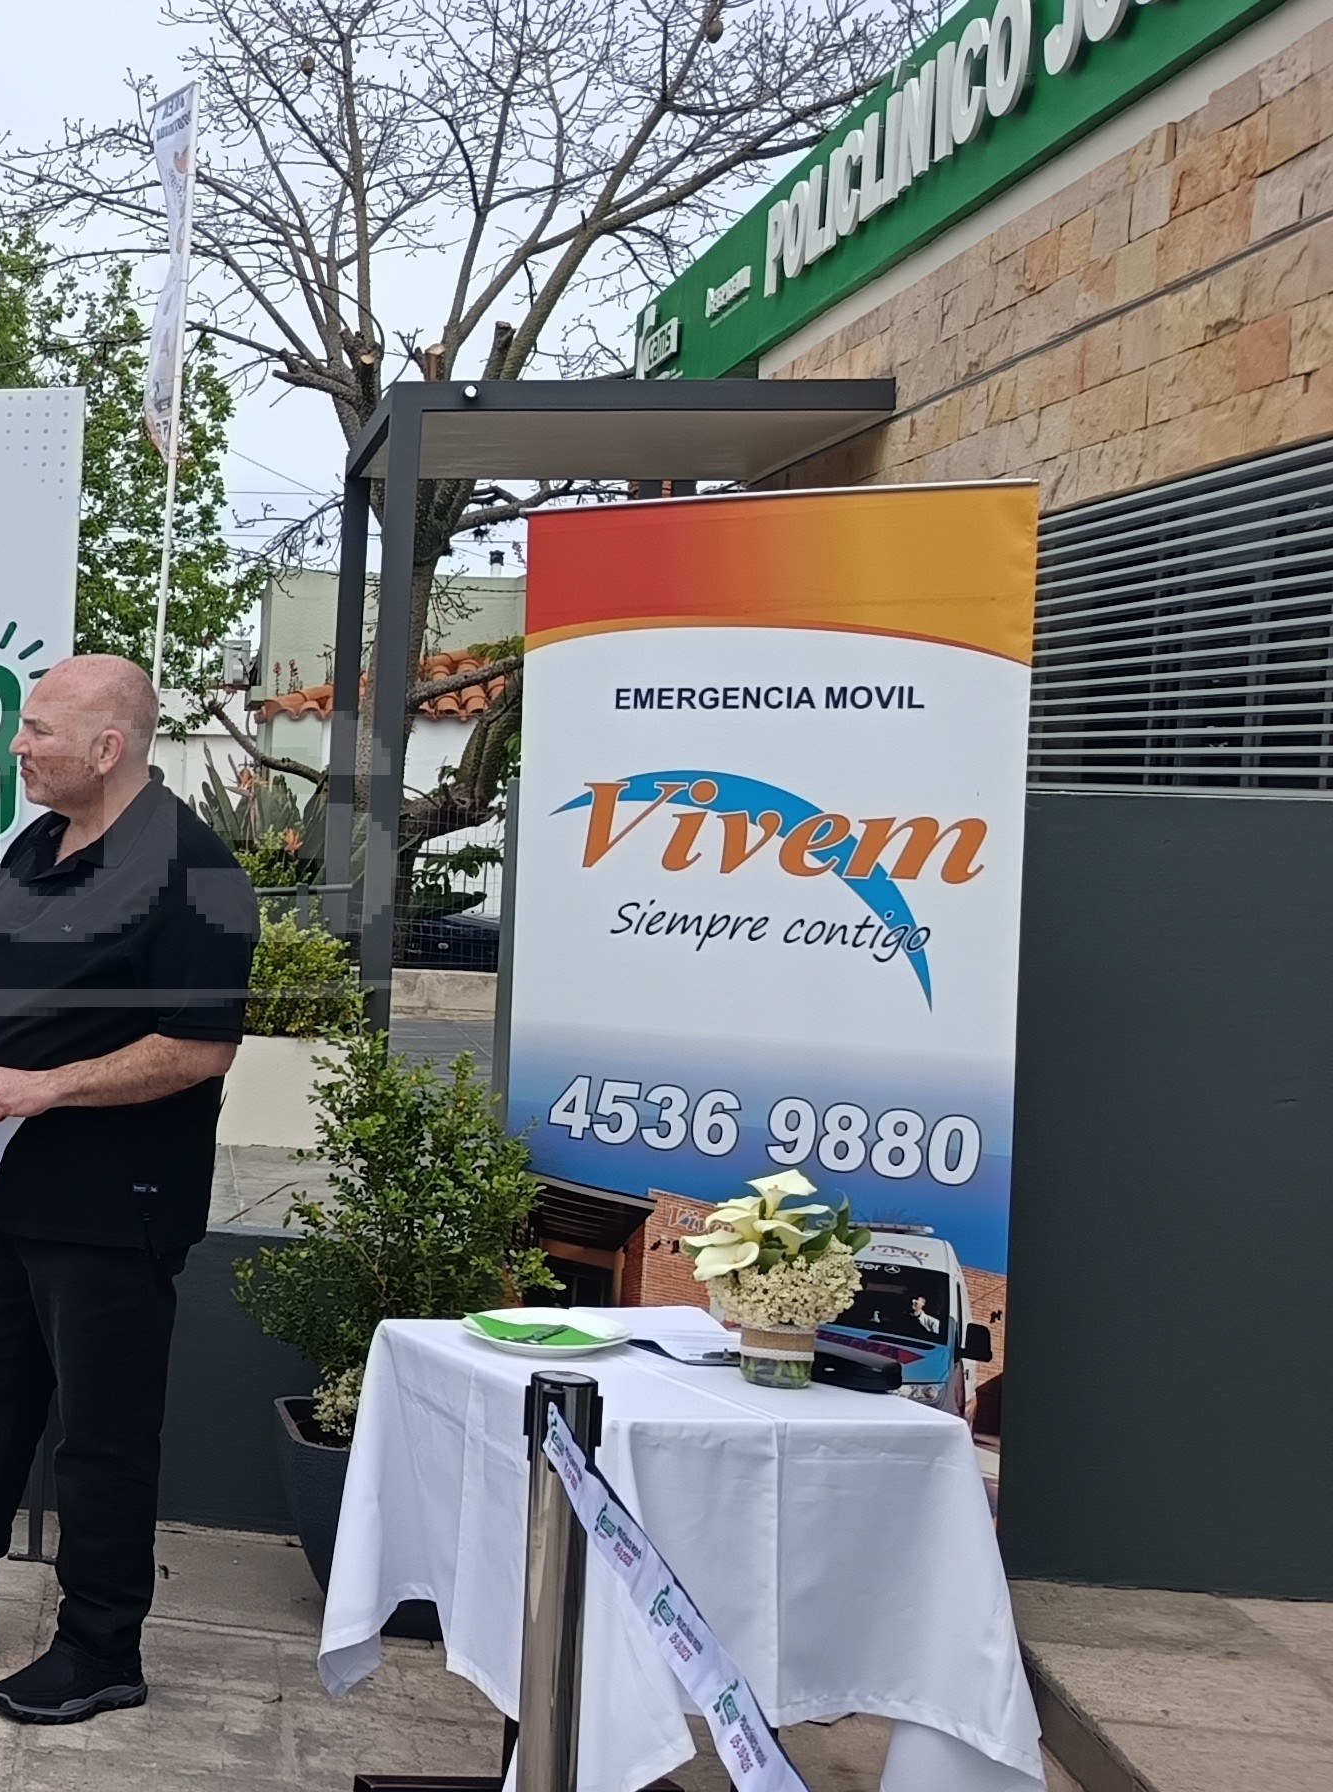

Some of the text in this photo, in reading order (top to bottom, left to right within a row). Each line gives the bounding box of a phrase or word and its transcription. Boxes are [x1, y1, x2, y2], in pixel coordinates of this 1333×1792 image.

[764, 0, 1031, 298] POLICLÍNICO
[615, 685, 925, 710] EMERGENCIA MOVIL
[581, 777, 990, 886] Vivem
[610, 899, 931, 963] Siempre contigo
[548, 1075, 982, 1186] 4536 9880
